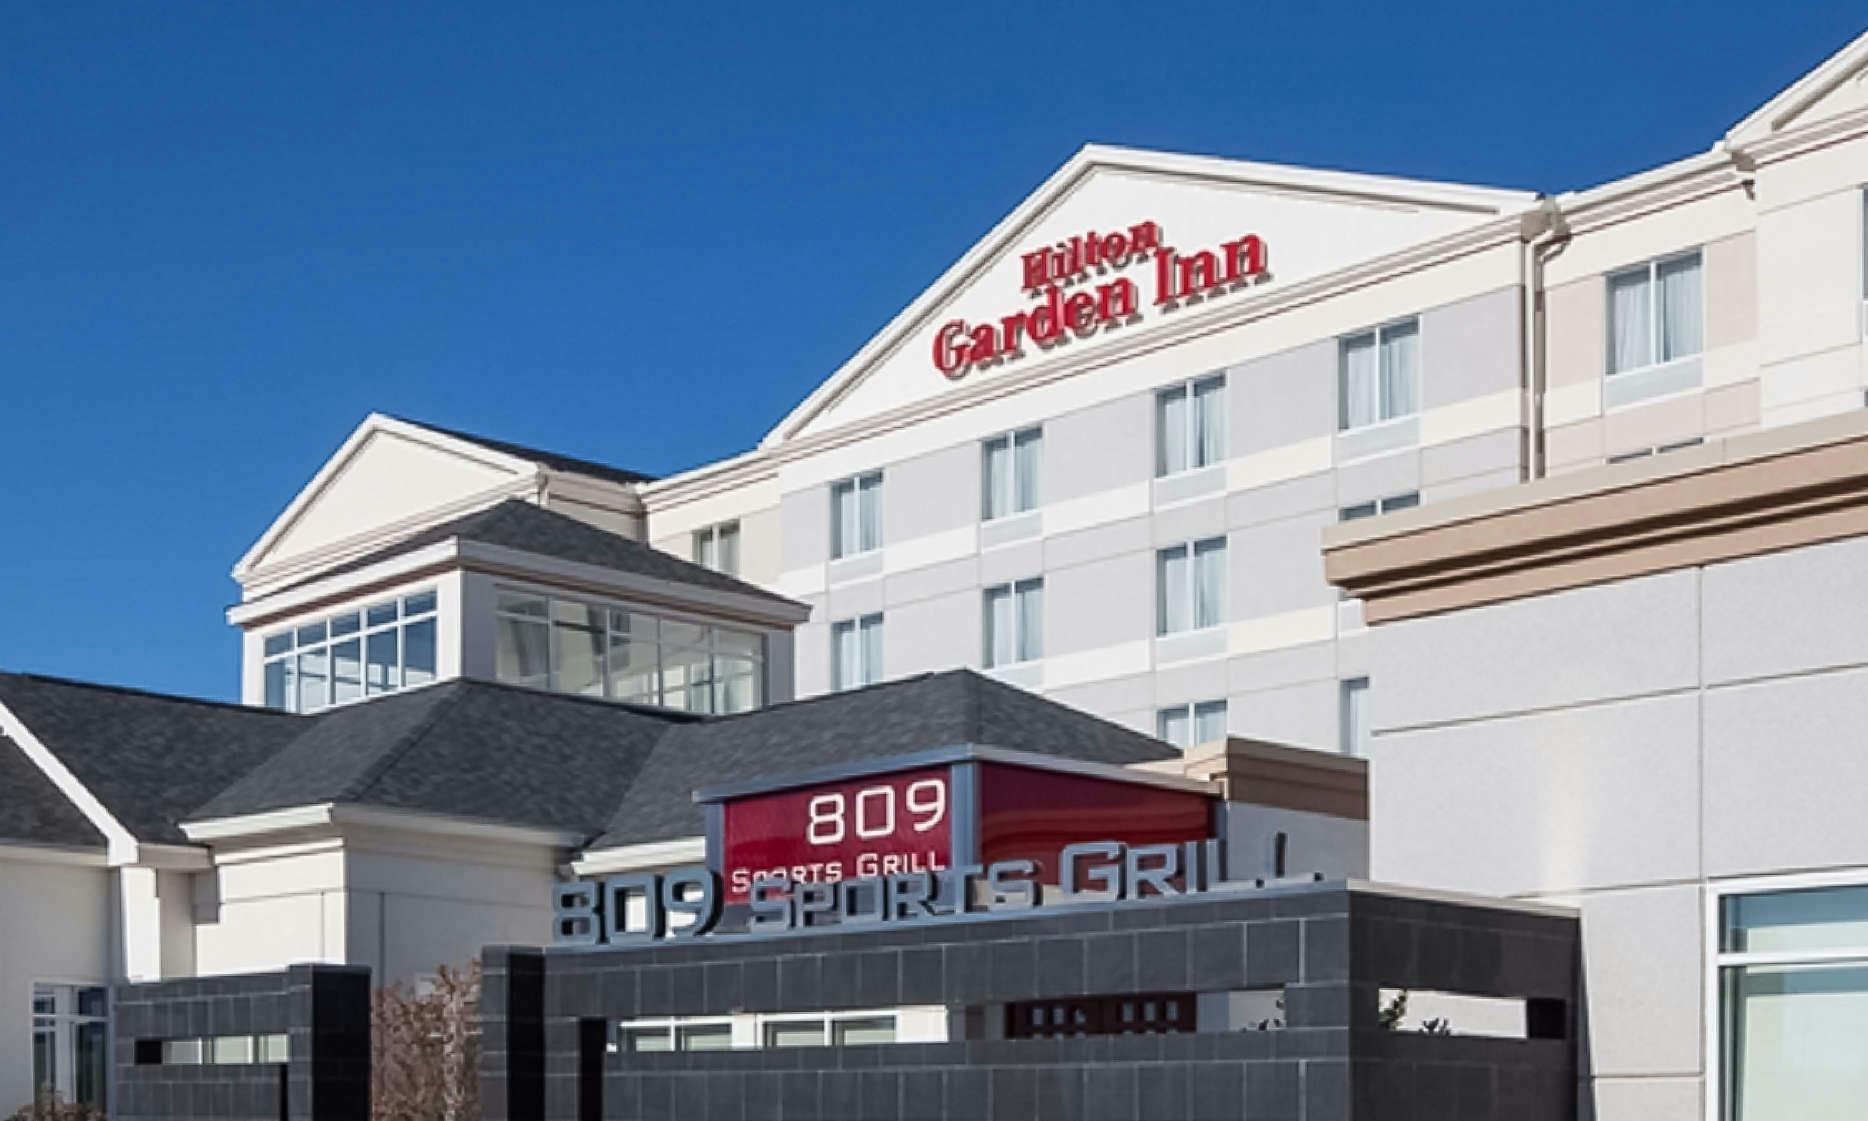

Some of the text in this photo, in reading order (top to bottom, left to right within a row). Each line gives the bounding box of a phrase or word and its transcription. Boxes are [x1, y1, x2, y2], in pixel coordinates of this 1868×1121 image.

[1020, 221, 1160, 294] Hilton
[932, 233, 1268, 374] Garden Inn
[806, 778, 946, 845] 809
[856, 850, 945, 877] GRILL
[554, 867, 718, 945] 809
[748, 860, 1036, 930] SPORTS
